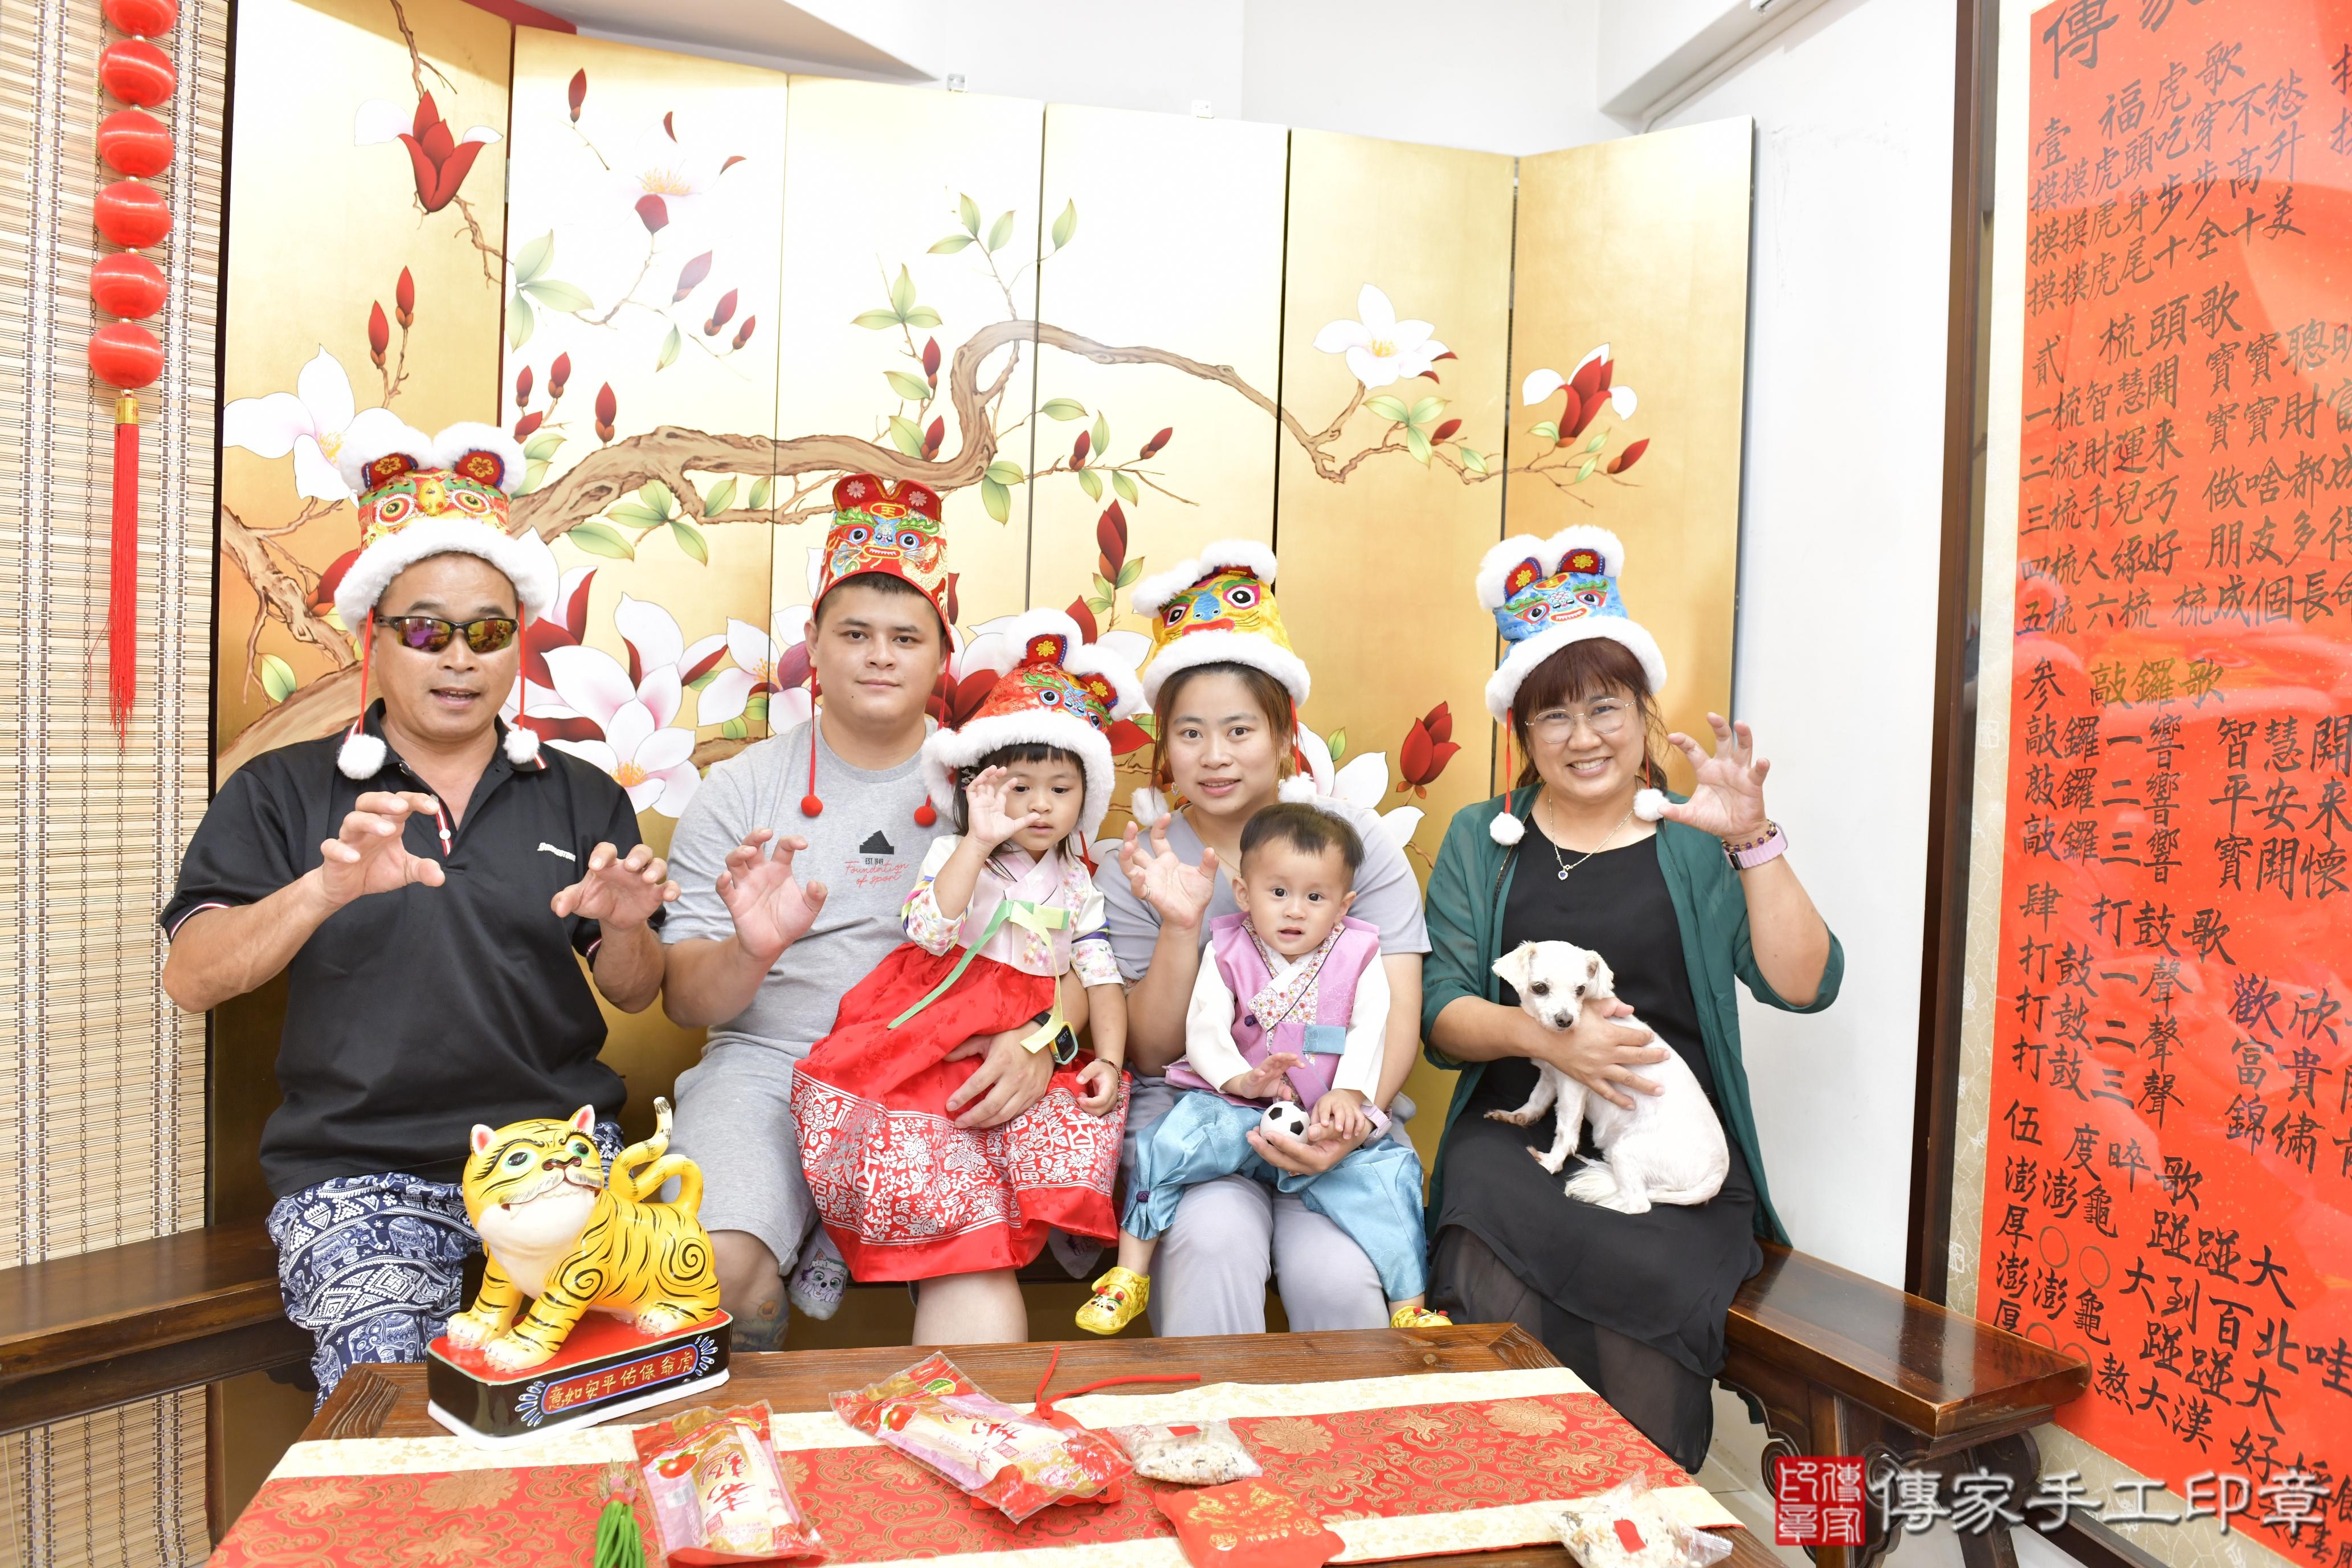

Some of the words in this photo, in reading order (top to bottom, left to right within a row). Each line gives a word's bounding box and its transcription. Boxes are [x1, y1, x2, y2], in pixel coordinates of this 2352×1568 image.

[2035, 117, 2071, 170] 壹
[2098, 40, 2247, 140] 福虎歌
[2026, 186, 2306, 317] 摸摸虎尾十全十美
[2098, 281, 2244, 366] 梳頭歌
[844, 860, 910, 876] Foundation
[2089, 893, 2237, 966] 打鼓歌
[2227, 972, 2352, 1047] 歡欣
[2231, 1034, 2352, 1115] 富貴
[2003, 1099, 2043, 1146] 伍
